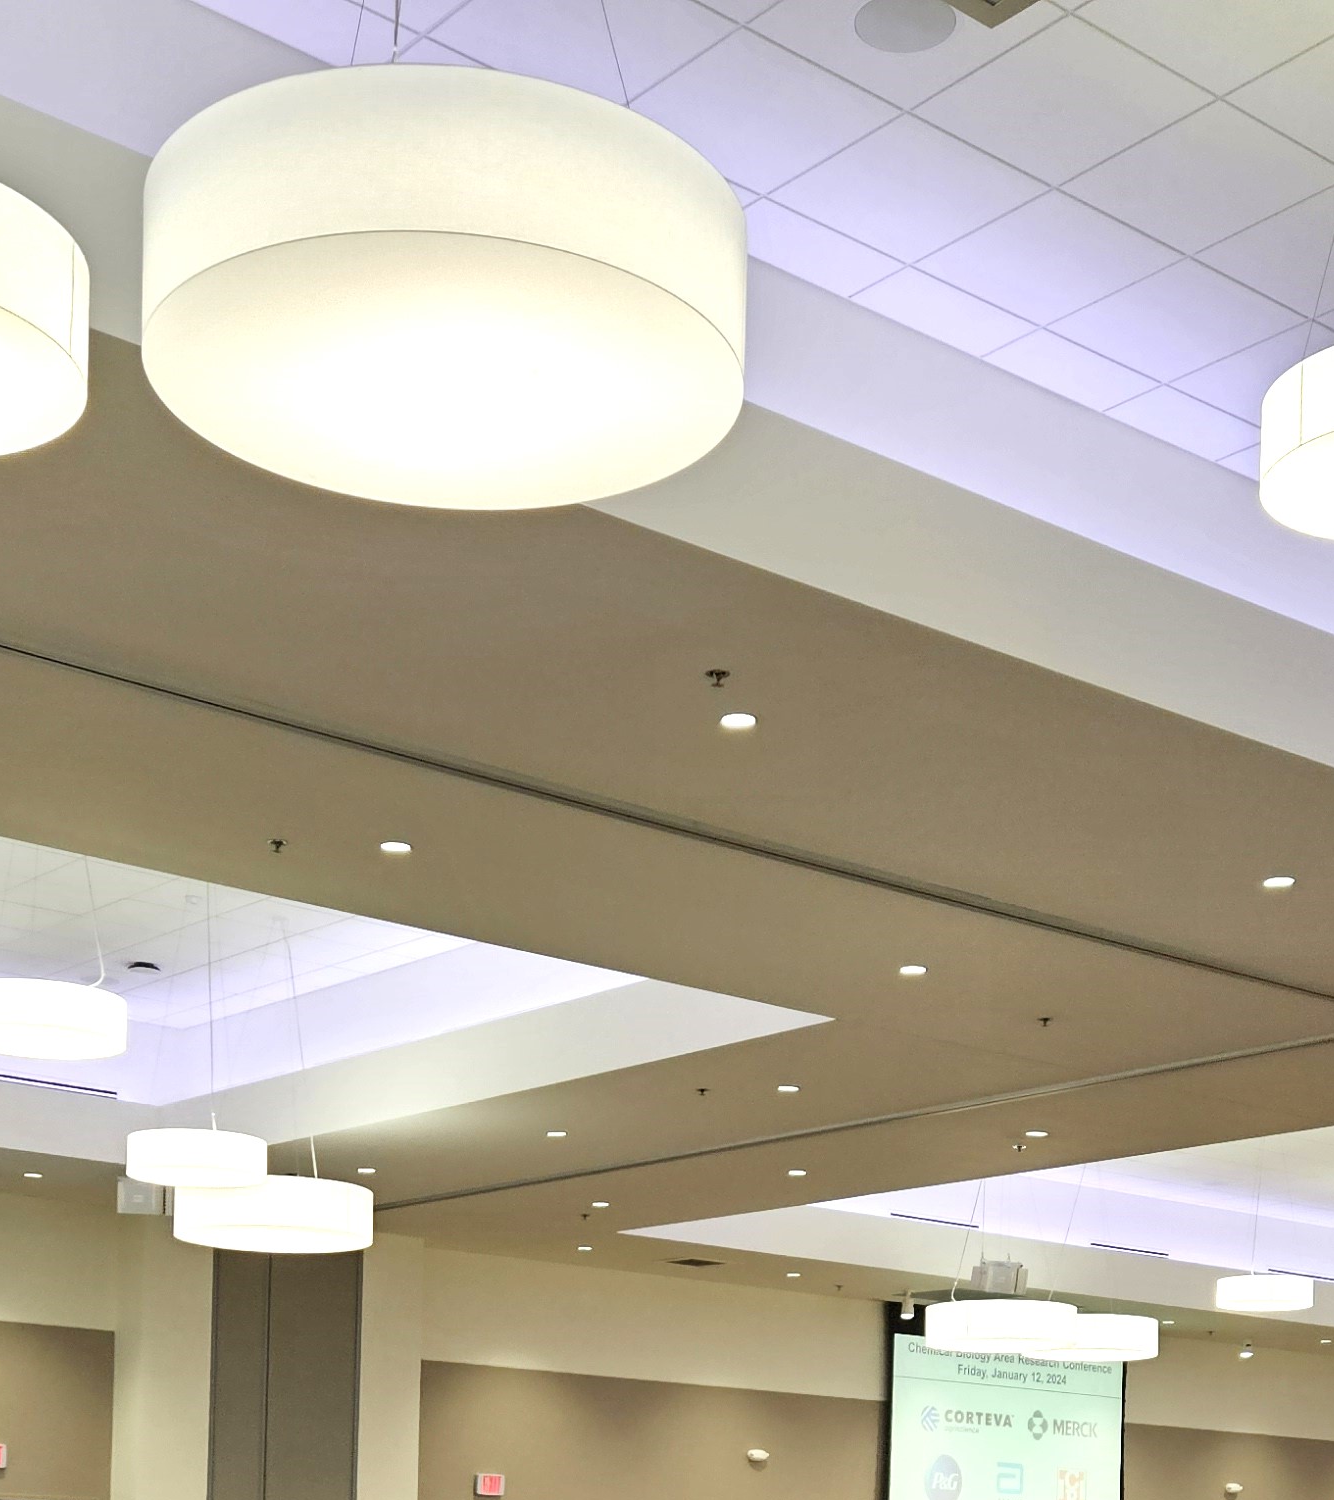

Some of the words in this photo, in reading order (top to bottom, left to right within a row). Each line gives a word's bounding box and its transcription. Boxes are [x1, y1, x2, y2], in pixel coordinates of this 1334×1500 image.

[957, 1363, 989, 1380] Friday,
[991, 1368, 1028, 1384] January
[1046, 1373, 1067, 1385] 2024
[1063, 1360, 1112, 1374] Conference
[944, 1409, 1012, 1428] CORTEVA
[1052, 1418, 1098, 1439] MERCK
[932, 1471, 959, 1491] P&G
